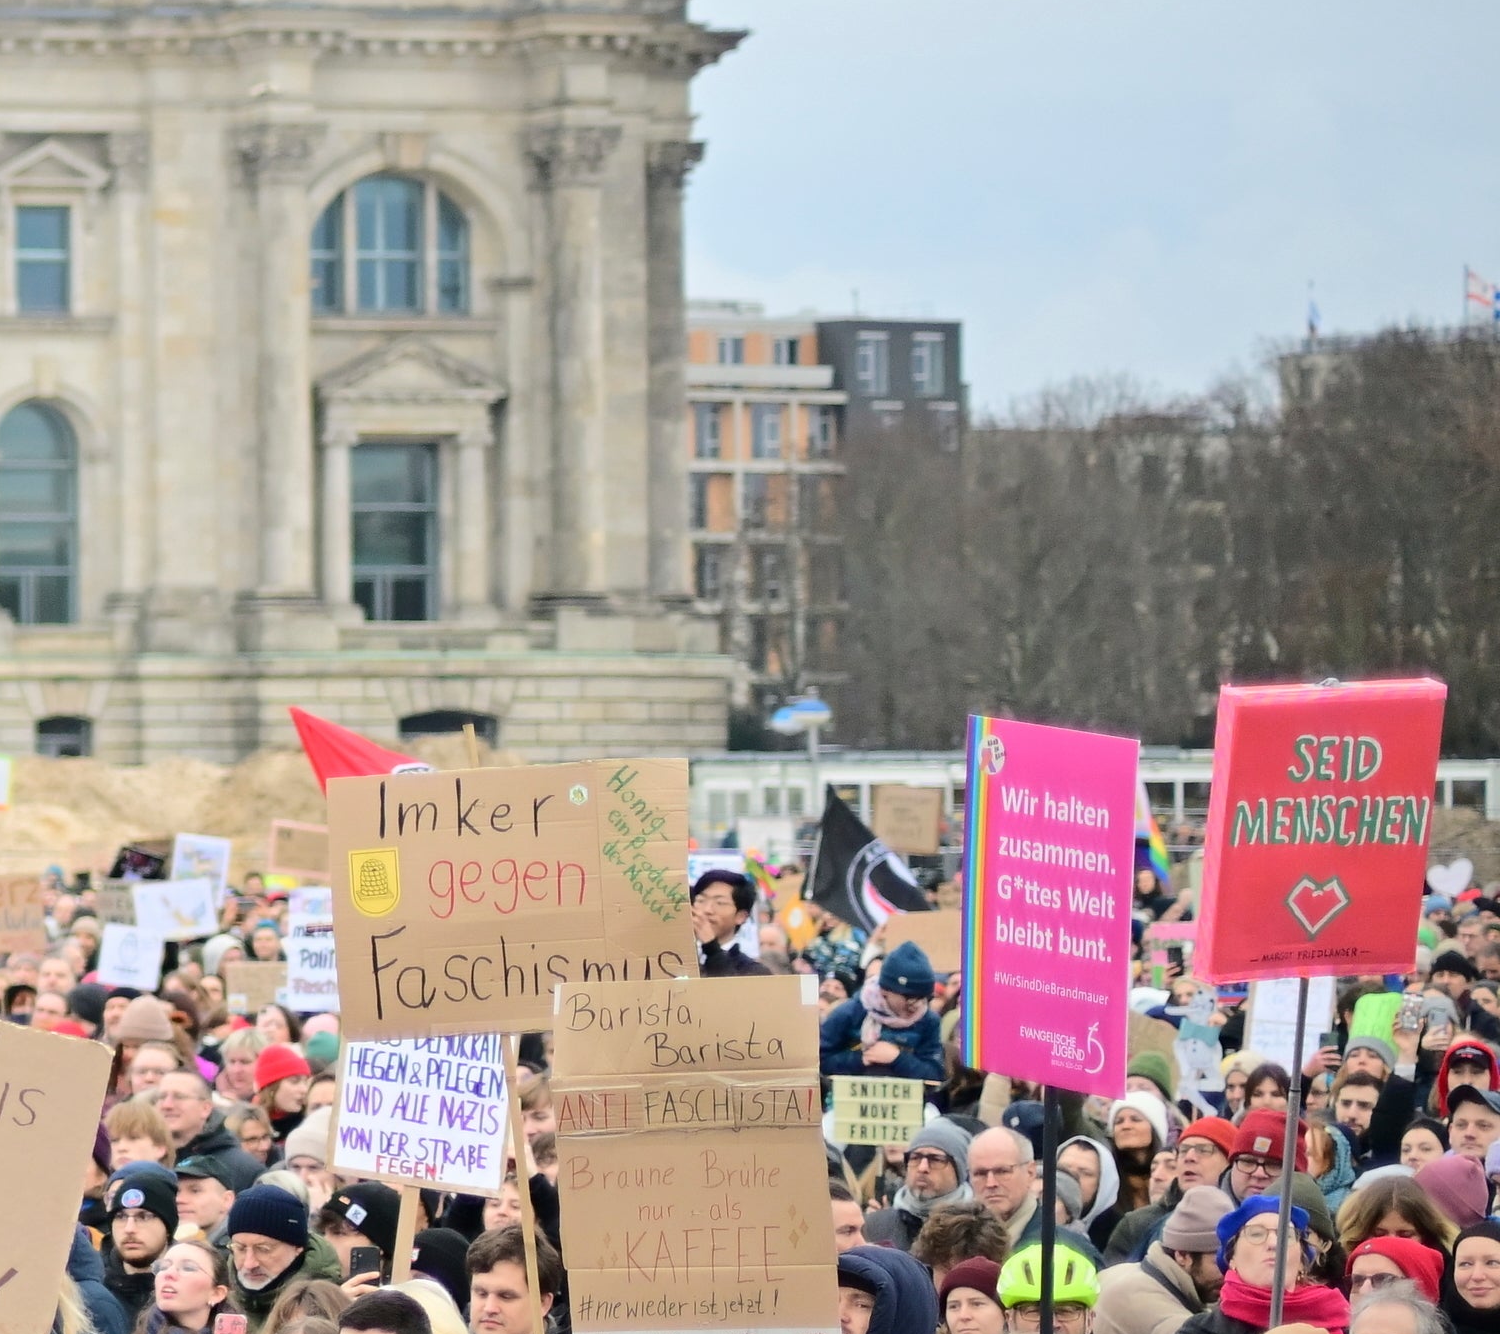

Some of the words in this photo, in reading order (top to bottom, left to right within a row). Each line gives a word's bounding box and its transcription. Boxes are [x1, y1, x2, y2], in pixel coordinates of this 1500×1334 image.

[1287, 733, 1383, 784] SEID
[380, 777, 555, 839] Imker
[1000, 785, 1039, 816] Wir
[1044, 791, 1110, 829] halten
[1230, 794, 1430, 847] MENSCHEN
[998, 835, 1117, 876] zusammen.
[428, 858, 587, 919] gegen
[1067, 885, 1116, 919] Welt
[995, 915, 1054, 952] bleibt
[1058, 927, 1113, 963] bunt.
[993, 970, 1110, 1006] #WirSindDieBrandmauer
[565, 989, 702, 1032] Barista,
[644, 1021, 785, 1068] Barista
[1019, 1025, 1077, 1048] EVANGELISCHE
[1050, 1043, 1086, 1062] JUGEND
[348, 1046, 409, 1085] HEGEN
[409, 1061, 423, 1088] &
[426, 1057, 505, 1102] PFLEGEN.
[850, 1083, 912, 1099] SNITCH
[346, 1082, 384, 1117] UND
[390, 1091, 431, 1126] ALLE
[438, 1094, 500, 1136] NAZIS
[558, 1092, 628, 1133] ANTI
[644, 1088, 815, 1126] FASCHISTA!
[860, 1105, 898, 1120] MOVE
[340, 1125, 373, 1154] VON
[379, 1130, 411, 1159] DER
[849, 1124, 910, 1142] FRITZE
[375, 1154, 445, 1181] FEGEN!
[566, 1155, 676, 1191] Braune
[700, 1149, 781, 1189] Brühe
[638, 1203, 676, 1221] nur
[709, 1193, 742, 1221] als
[625, 1225, 786, 1285] KAFFEE
